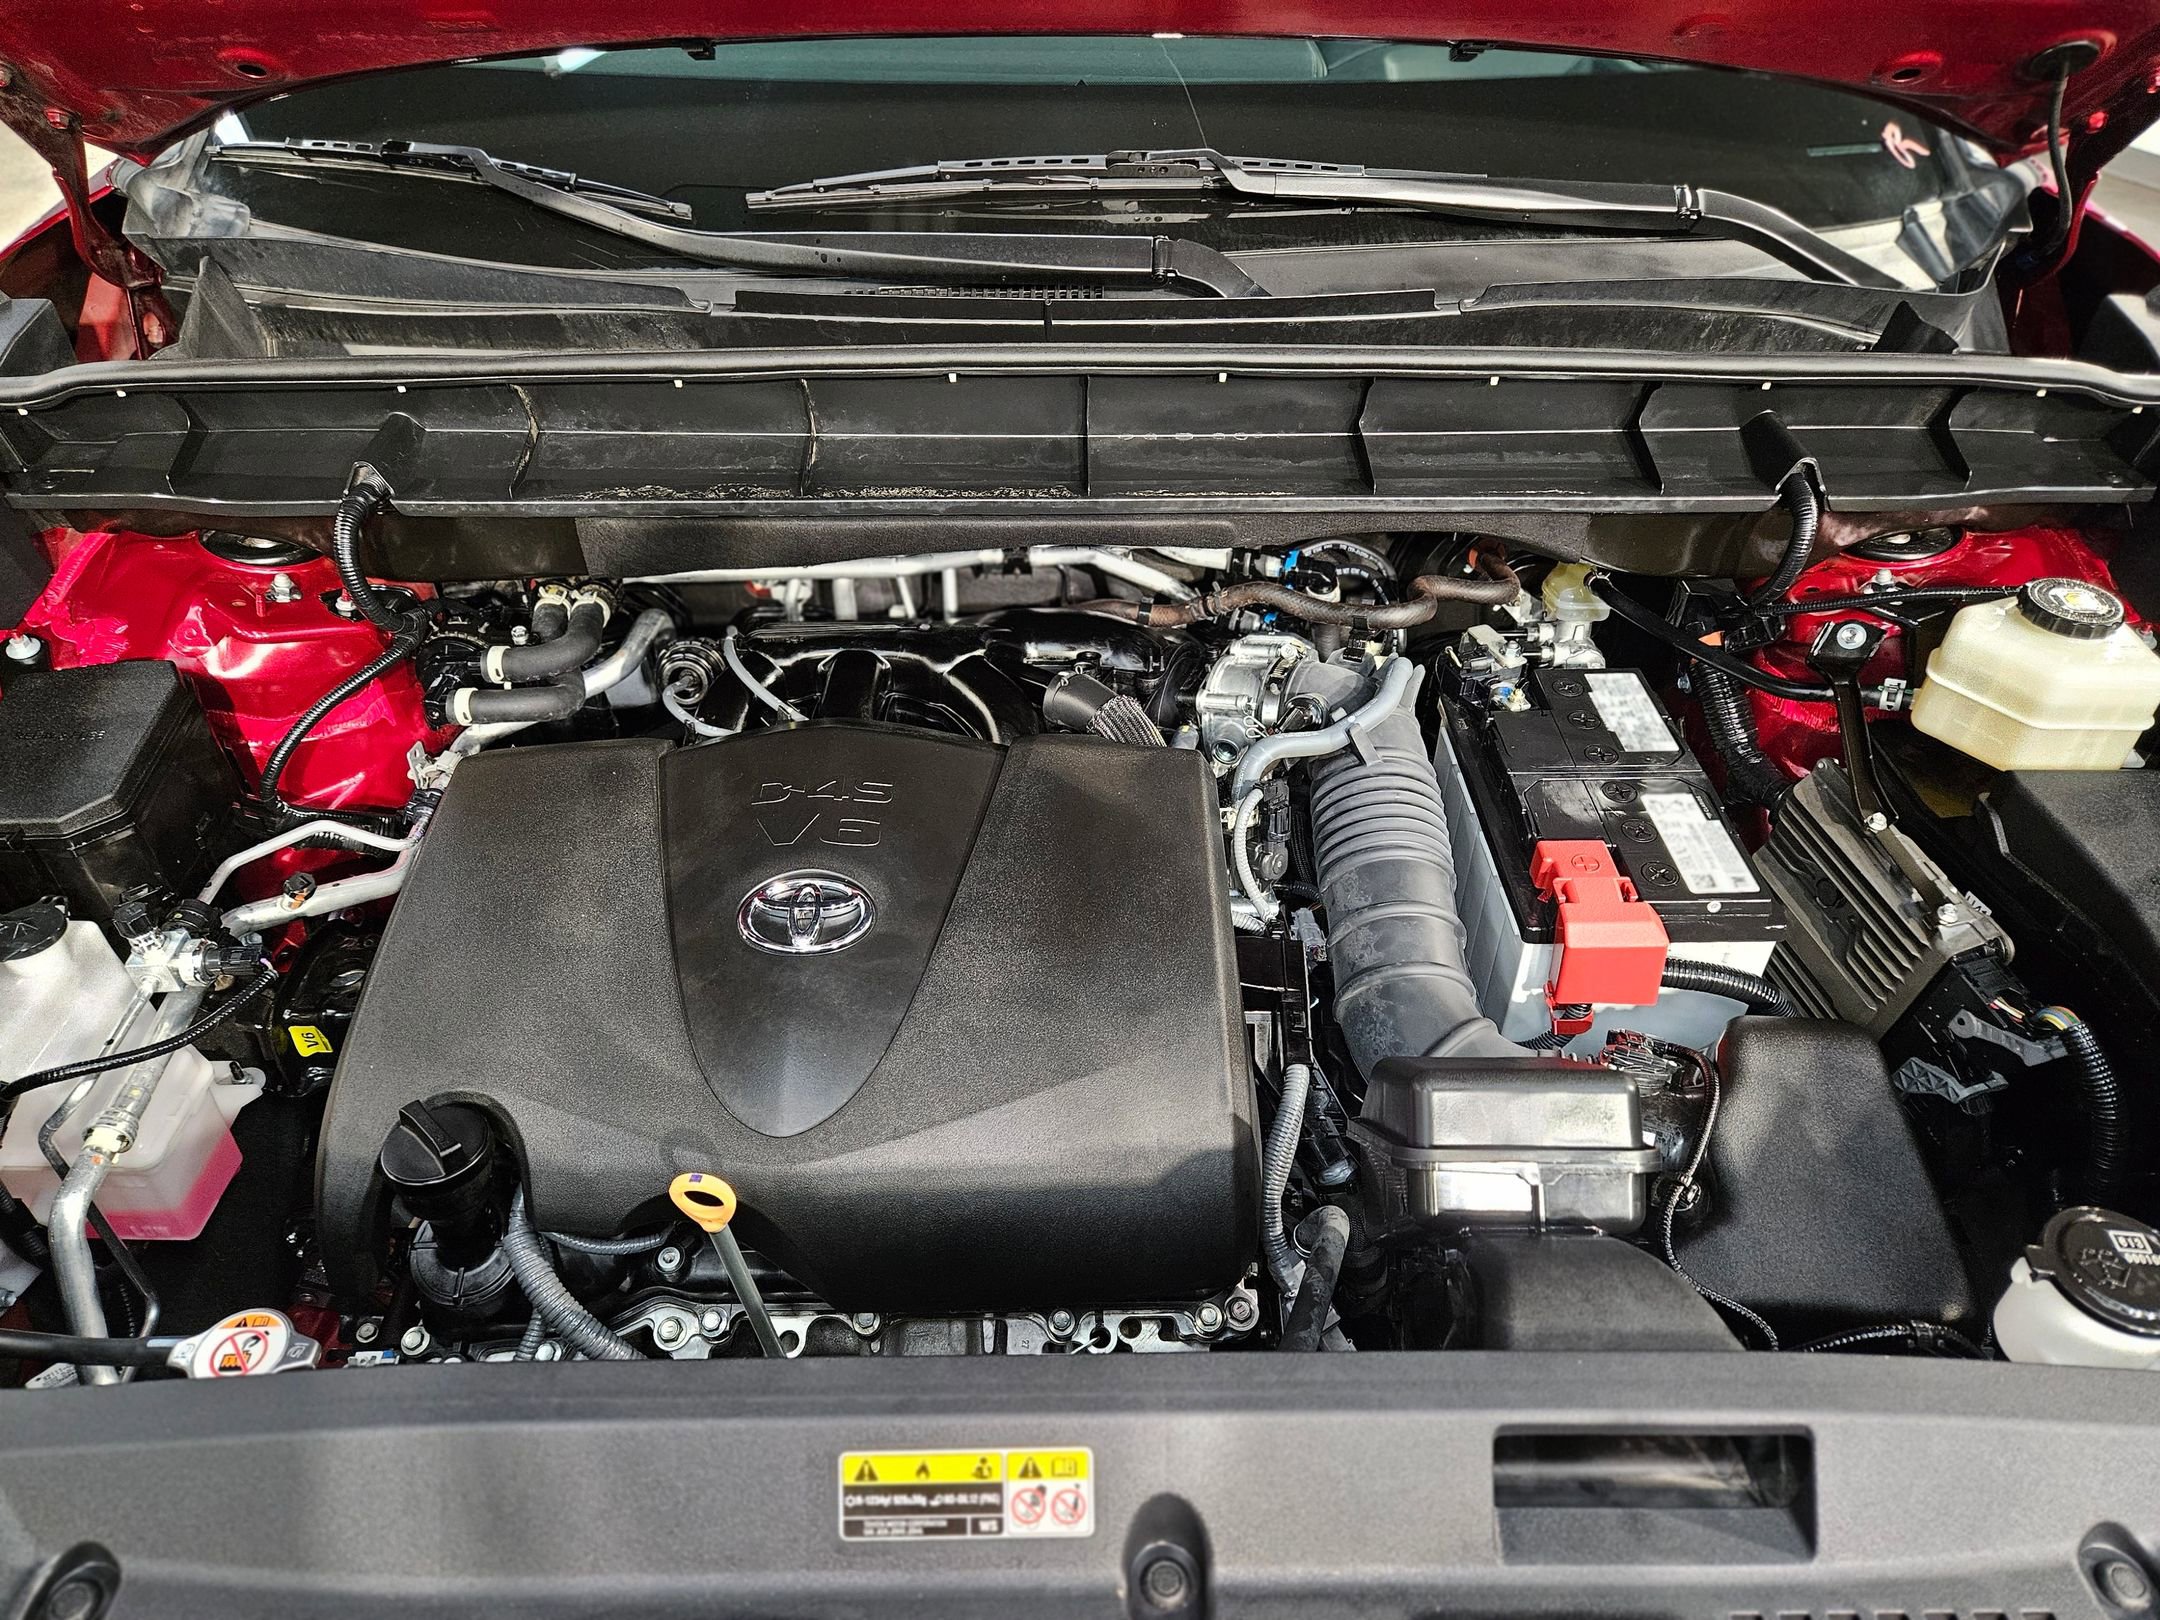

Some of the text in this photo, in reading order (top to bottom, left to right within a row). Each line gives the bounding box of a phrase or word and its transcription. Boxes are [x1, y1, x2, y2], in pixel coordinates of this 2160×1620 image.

[751, 777, 894, 806] D-4S
[756, 812, 882, 847] V6
[301, 1032, 319, 1049] V6
